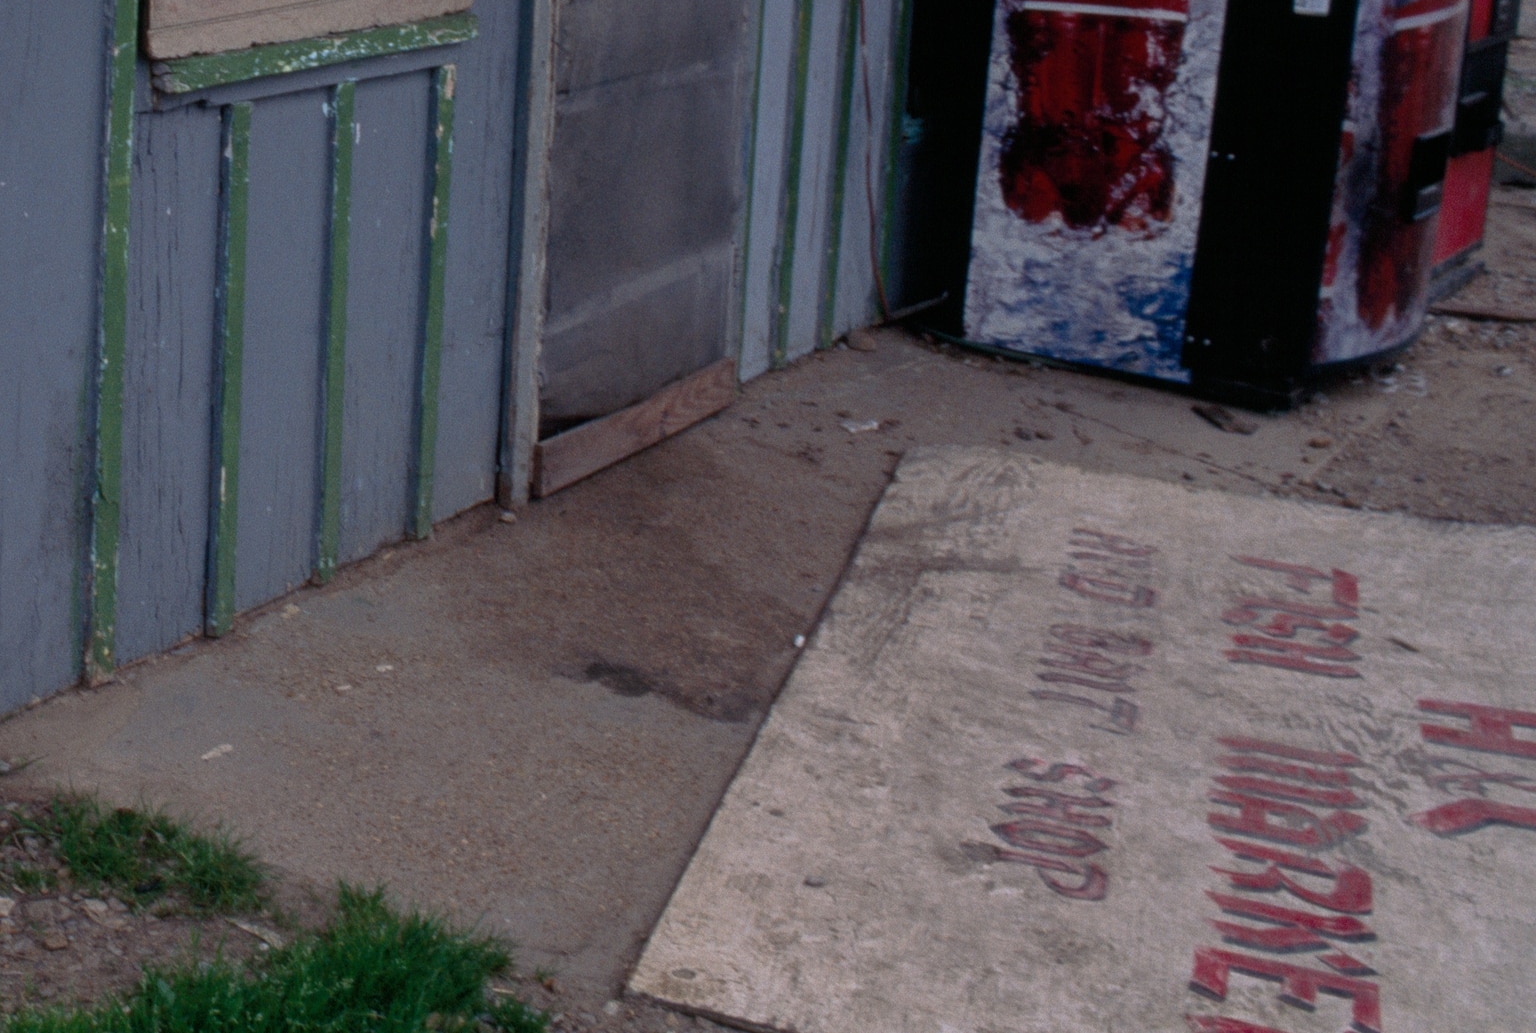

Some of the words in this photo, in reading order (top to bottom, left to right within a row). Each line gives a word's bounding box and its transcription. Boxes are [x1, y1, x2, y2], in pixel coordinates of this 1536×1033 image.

[1220, 553, 1366, 680] FISH
[989, 756, 1120, 902] SHOP
[1186, 735, 1383, 1033] MARKE
